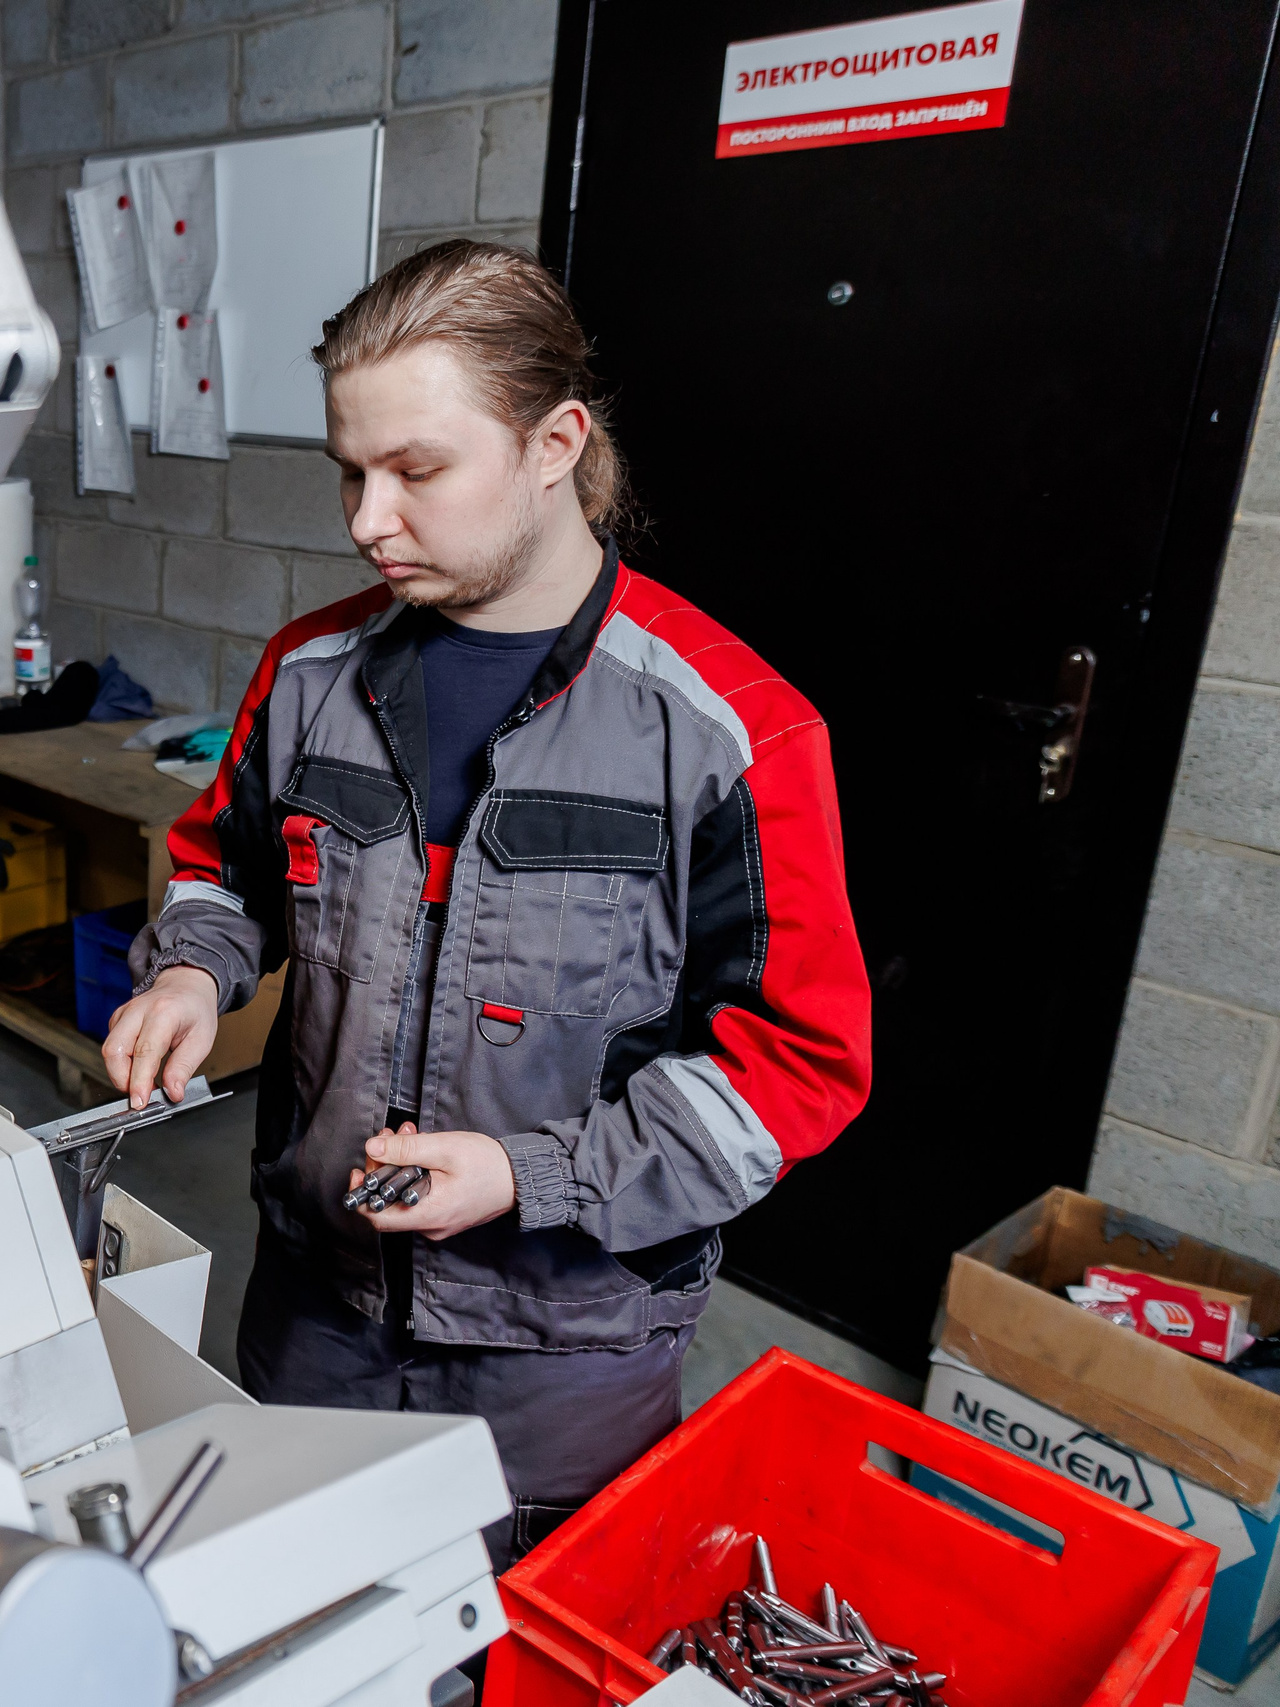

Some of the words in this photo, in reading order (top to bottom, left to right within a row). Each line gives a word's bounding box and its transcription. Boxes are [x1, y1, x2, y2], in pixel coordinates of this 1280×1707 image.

[736, 32, 1000, 92] ЭЛЕКТРОЩИТОВАЯ
[846, 112, 893, 132] ВХОД
[953, 1390, 1131, 1503] NEOKEM
